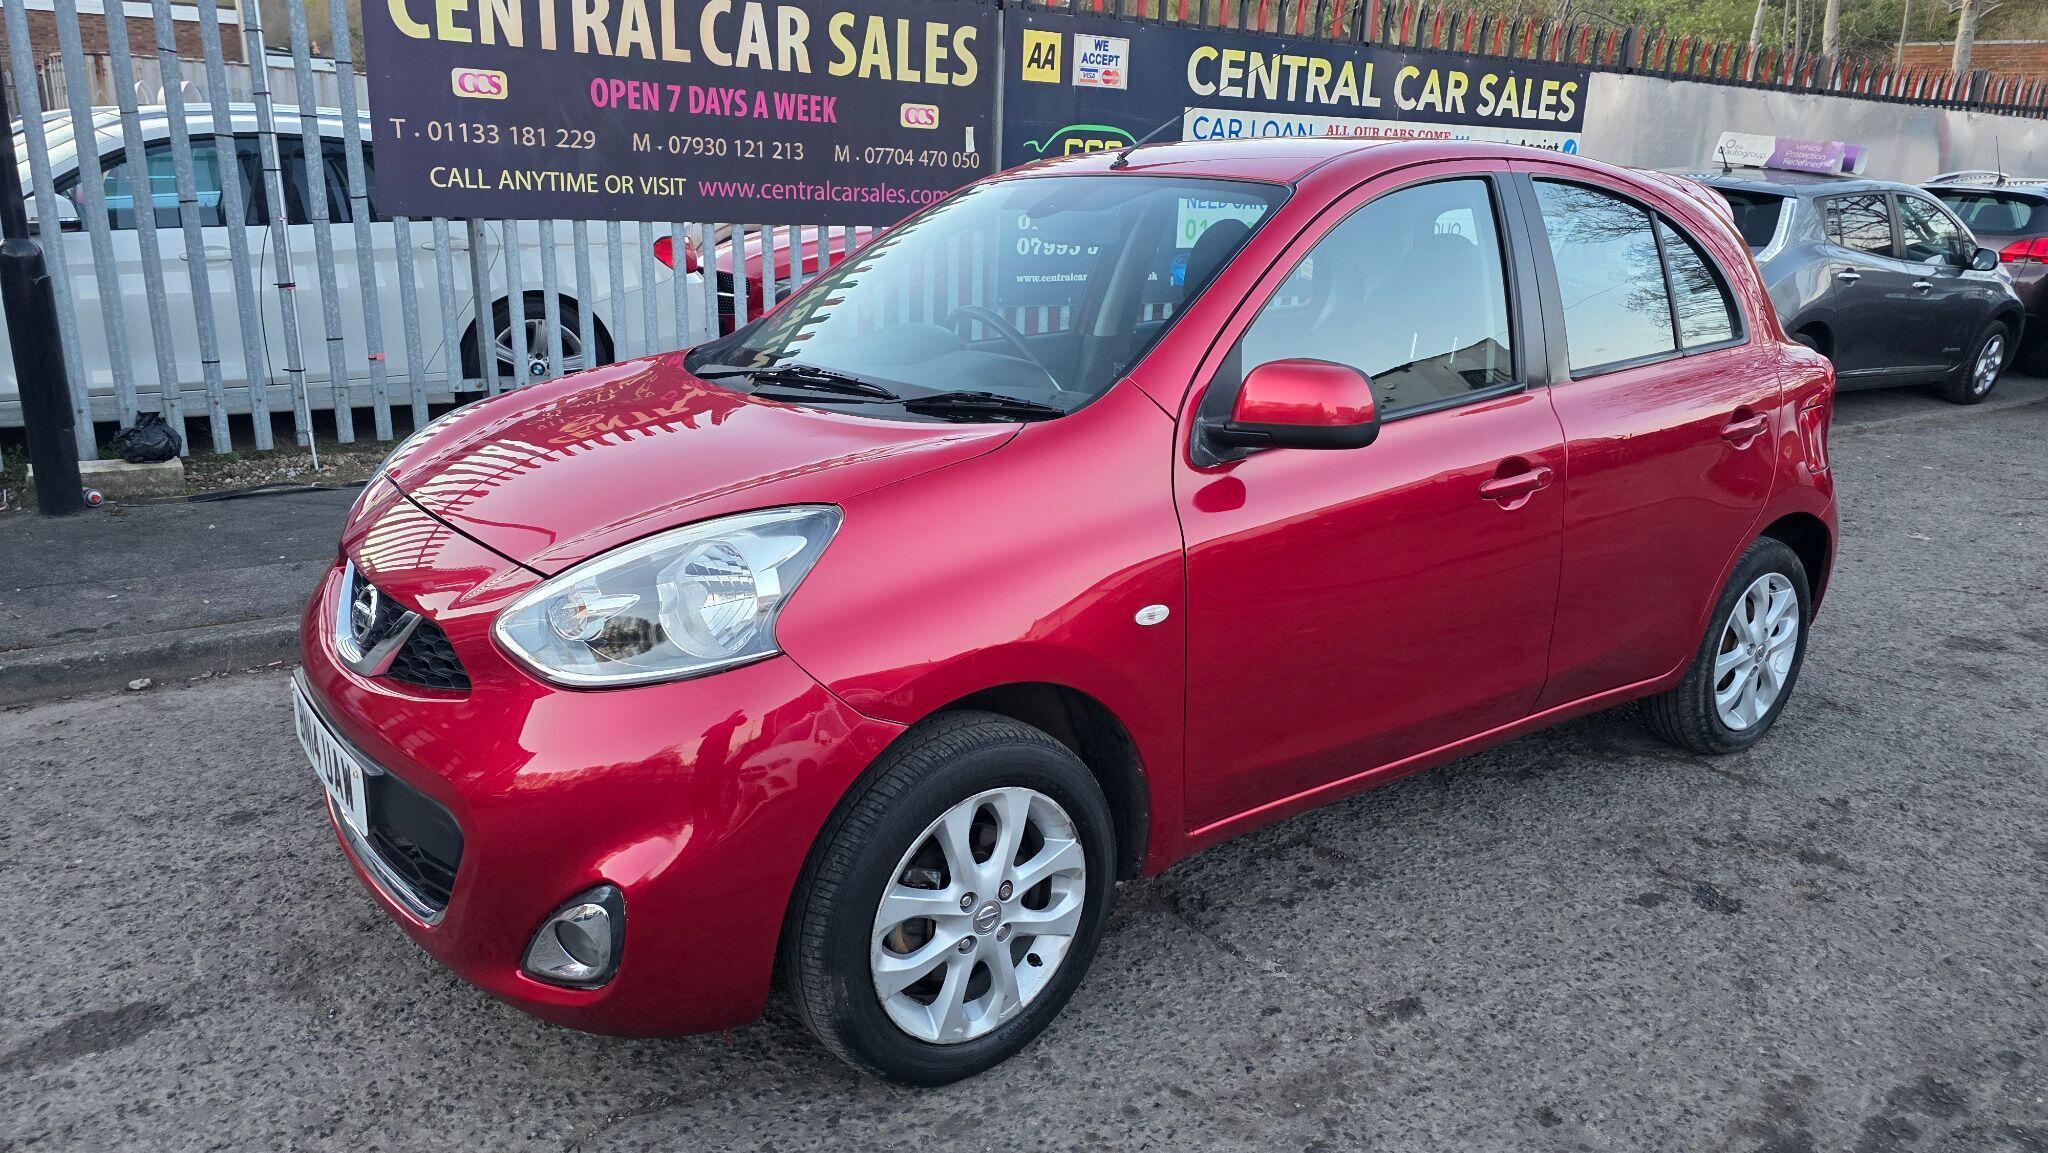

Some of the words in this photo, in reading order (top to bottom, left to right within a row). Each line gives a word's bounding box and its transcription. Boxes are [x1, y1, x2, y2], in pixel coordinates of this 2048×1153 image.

[387, 0, 692, 63] CENTRAL
[700, 0, 812, 74] CAR
[828, 11, 978, 87] SALES
[1027, 42, 1056, 70] AA
[1094, 39, 1109, 52] WE
[1081, 52, 1120, 67] ACCEPT
[1187, 45, 1381, 108] CENTRAL
[1393, 65, 1469, 114] CAR
[1476, 73, 1578, 122] SALES
[590, 77, 660, 112] OPEN
[666, 84, 681, 113] 7
[688, 85, 748, 118] DAYS
[753, 91, 768, 119] A
[774, 92, 838, 123] WEEK
[427, 120, 500, 145] 01133
[509, 126, 546, 147] 181
[556, 129, 596, 149] 229
[1193, 115, 1243, 140] CAR
[1326, 124, 1349, 136] ALL
[668, 135, 727, 157] 07930
[734, 139, 764, 158] 121
[772, 141, 804, 160] 213
[864, 147, 914, 166] 07704
[918, 150, 948, 167] 470
[952, 151, 980, 169] 050
[1785, 150, 1826, 160] Protection
[1783, 158, 1824, 168] Redefined
[430, 166, 491, 189] CALL
[498, 169, 599, 193] ANYTIME
[604, 174, 634, 194] OR
[639, 176, 686, 196] VISIT
[698, 180, 949, 204] www.centralcarsales.com
